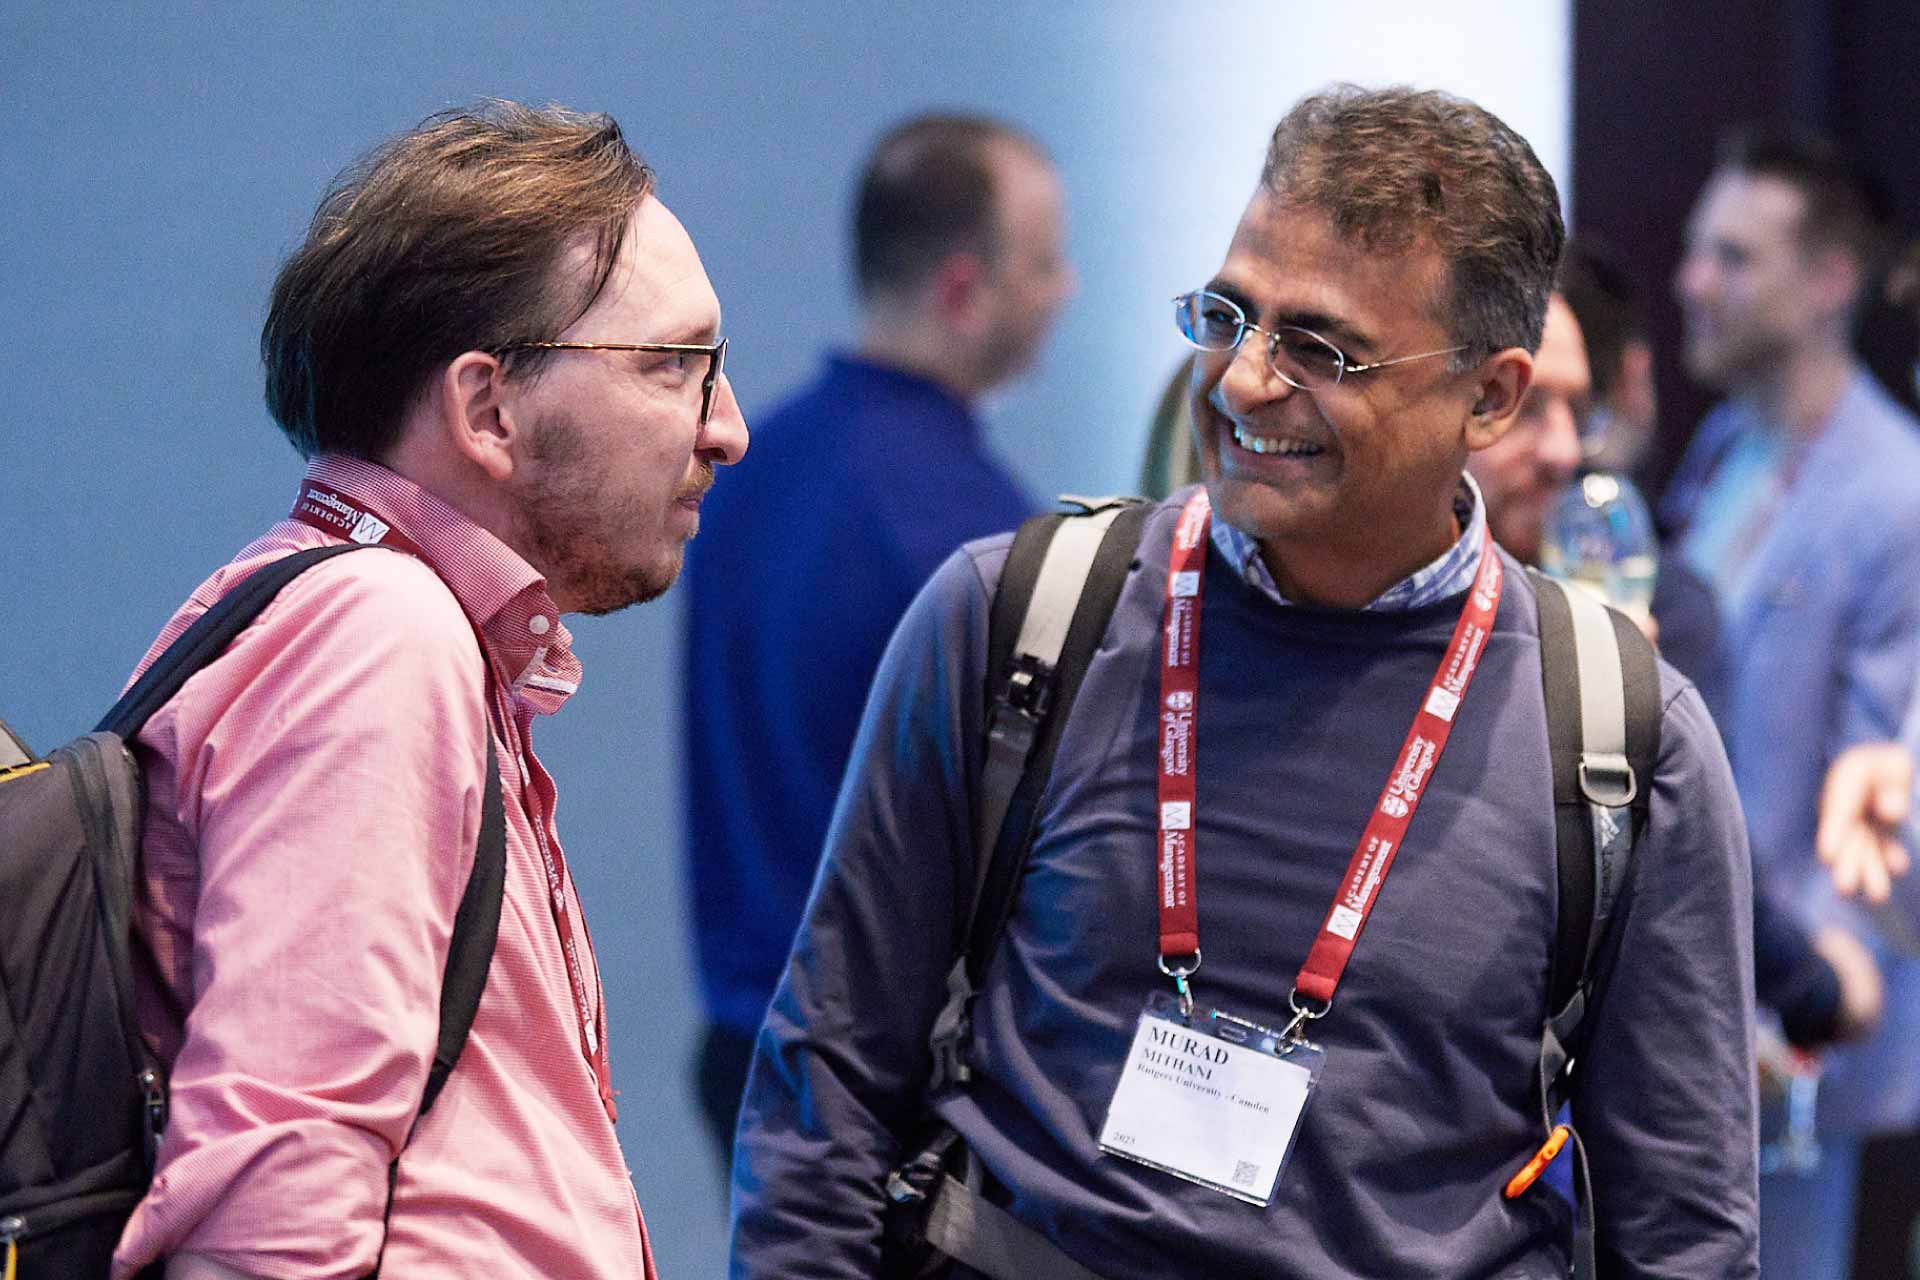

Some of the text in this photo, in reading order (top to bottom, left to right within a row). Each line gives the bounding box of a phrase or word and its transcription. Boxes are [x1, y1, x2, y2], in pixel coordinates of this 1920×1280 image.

[1161, 725, 1176, 776] Glasgow
[1174, 711, 1192, 776] University
[1388, 735, 1425, 796] University
[1160, 831, 1178, 909] Management
[1177, 834, 1186, 888] ACADEMY
[1344, 852, 1374, 905] ACADEMY
[1351, 839, 1393, 914] Management
[1142, 1047, 1213, 1081] MITHANI
[1147, 1026, 1230, 1066] MURAD
[1137, 1063, 1174, 1085] Rutgers
[1176, 1074, 1222, 1102] University
